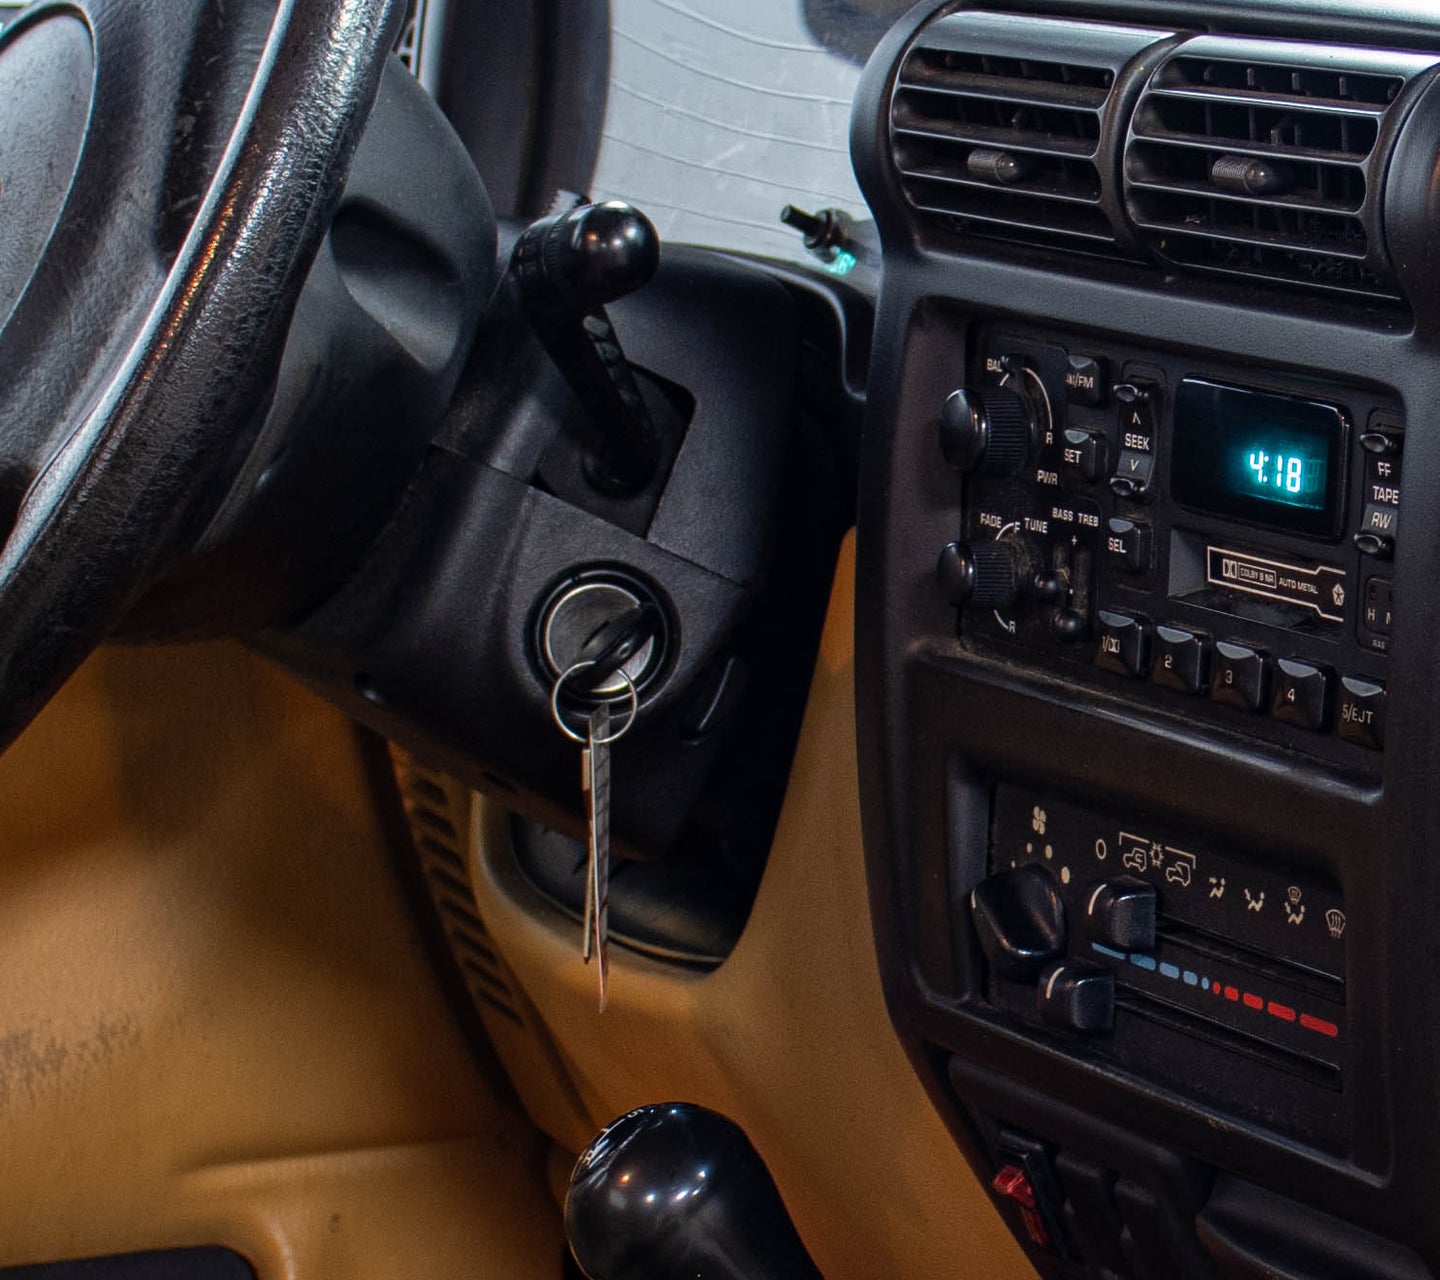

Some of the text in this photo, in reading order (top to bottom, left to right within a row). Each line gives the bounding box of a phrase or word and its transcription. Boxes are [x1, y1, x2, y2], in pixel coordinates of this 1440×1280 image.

[986, 358, 1003, 373] BAL
[1045, 431, 1054, 445] R
[1124, 433, 1150, 451] SEEK
[1063, 448, 1082, 464] SET
[1037, 469, 1058, 485] PWR
[1249, 450, 1302, 493] 4:18
[1377, 461, 1392, 478] FF
[1372, 485, 1400, 505] TAPE
[980, 512, 1002, 529] FADE
[1024, 517, 1048, 534] TUNE
[1052, 507, 1099, 528] BASS TREB
[1371, 511, 1392, 529] RW
[1013, 521, 1021, 534] F
[1107, 537, 1127, 554] SEL
[1240, 567, 1258, 579] DOLBY
[1264, 573, 1274, 583] NR
[1279, 576, 1319, 595] AUTO METAL
[1367, 607, 1376, 621] H
[1008, 620, 1016, 633] R
[1164, 654, 1173, 669] 2
[1225, 670, 1233, 684] 3
[1287, 688, 1295, 702] 4
[1342, 704, 1373, 725] 5/EJT
